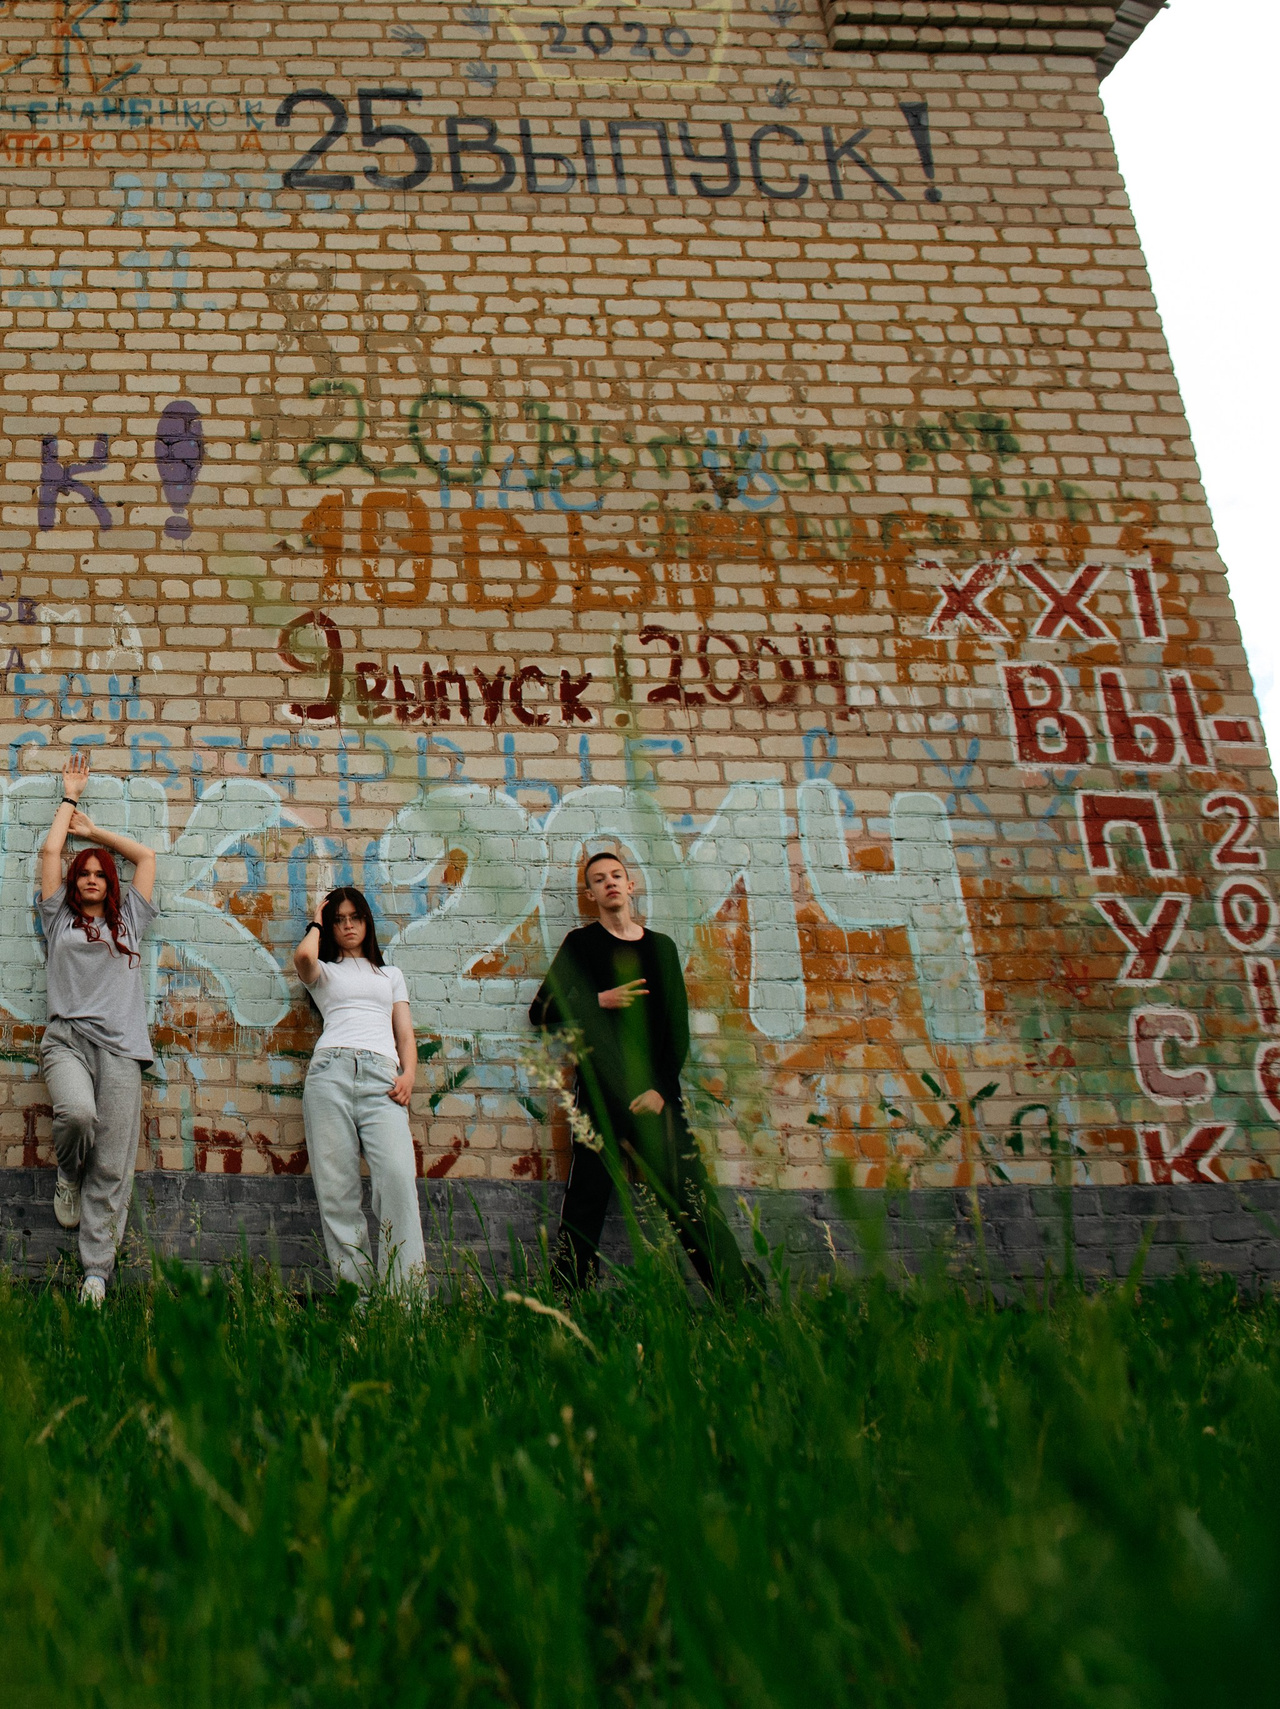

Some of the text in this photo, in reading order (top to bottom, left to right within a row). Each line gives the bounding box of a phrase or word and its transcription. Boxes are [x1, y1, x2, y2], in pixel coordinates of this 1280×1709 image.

[540, 20, 694, 57] 2020
[274, 87, 944, 203] 25 ВЫПУСК!
[918, 546, 1169, 643] XXI
[275, 609, 346, 720] 9
[998, 660, 1259, 772] ВЫ-
[377, 779, 987, 1044] 2014
